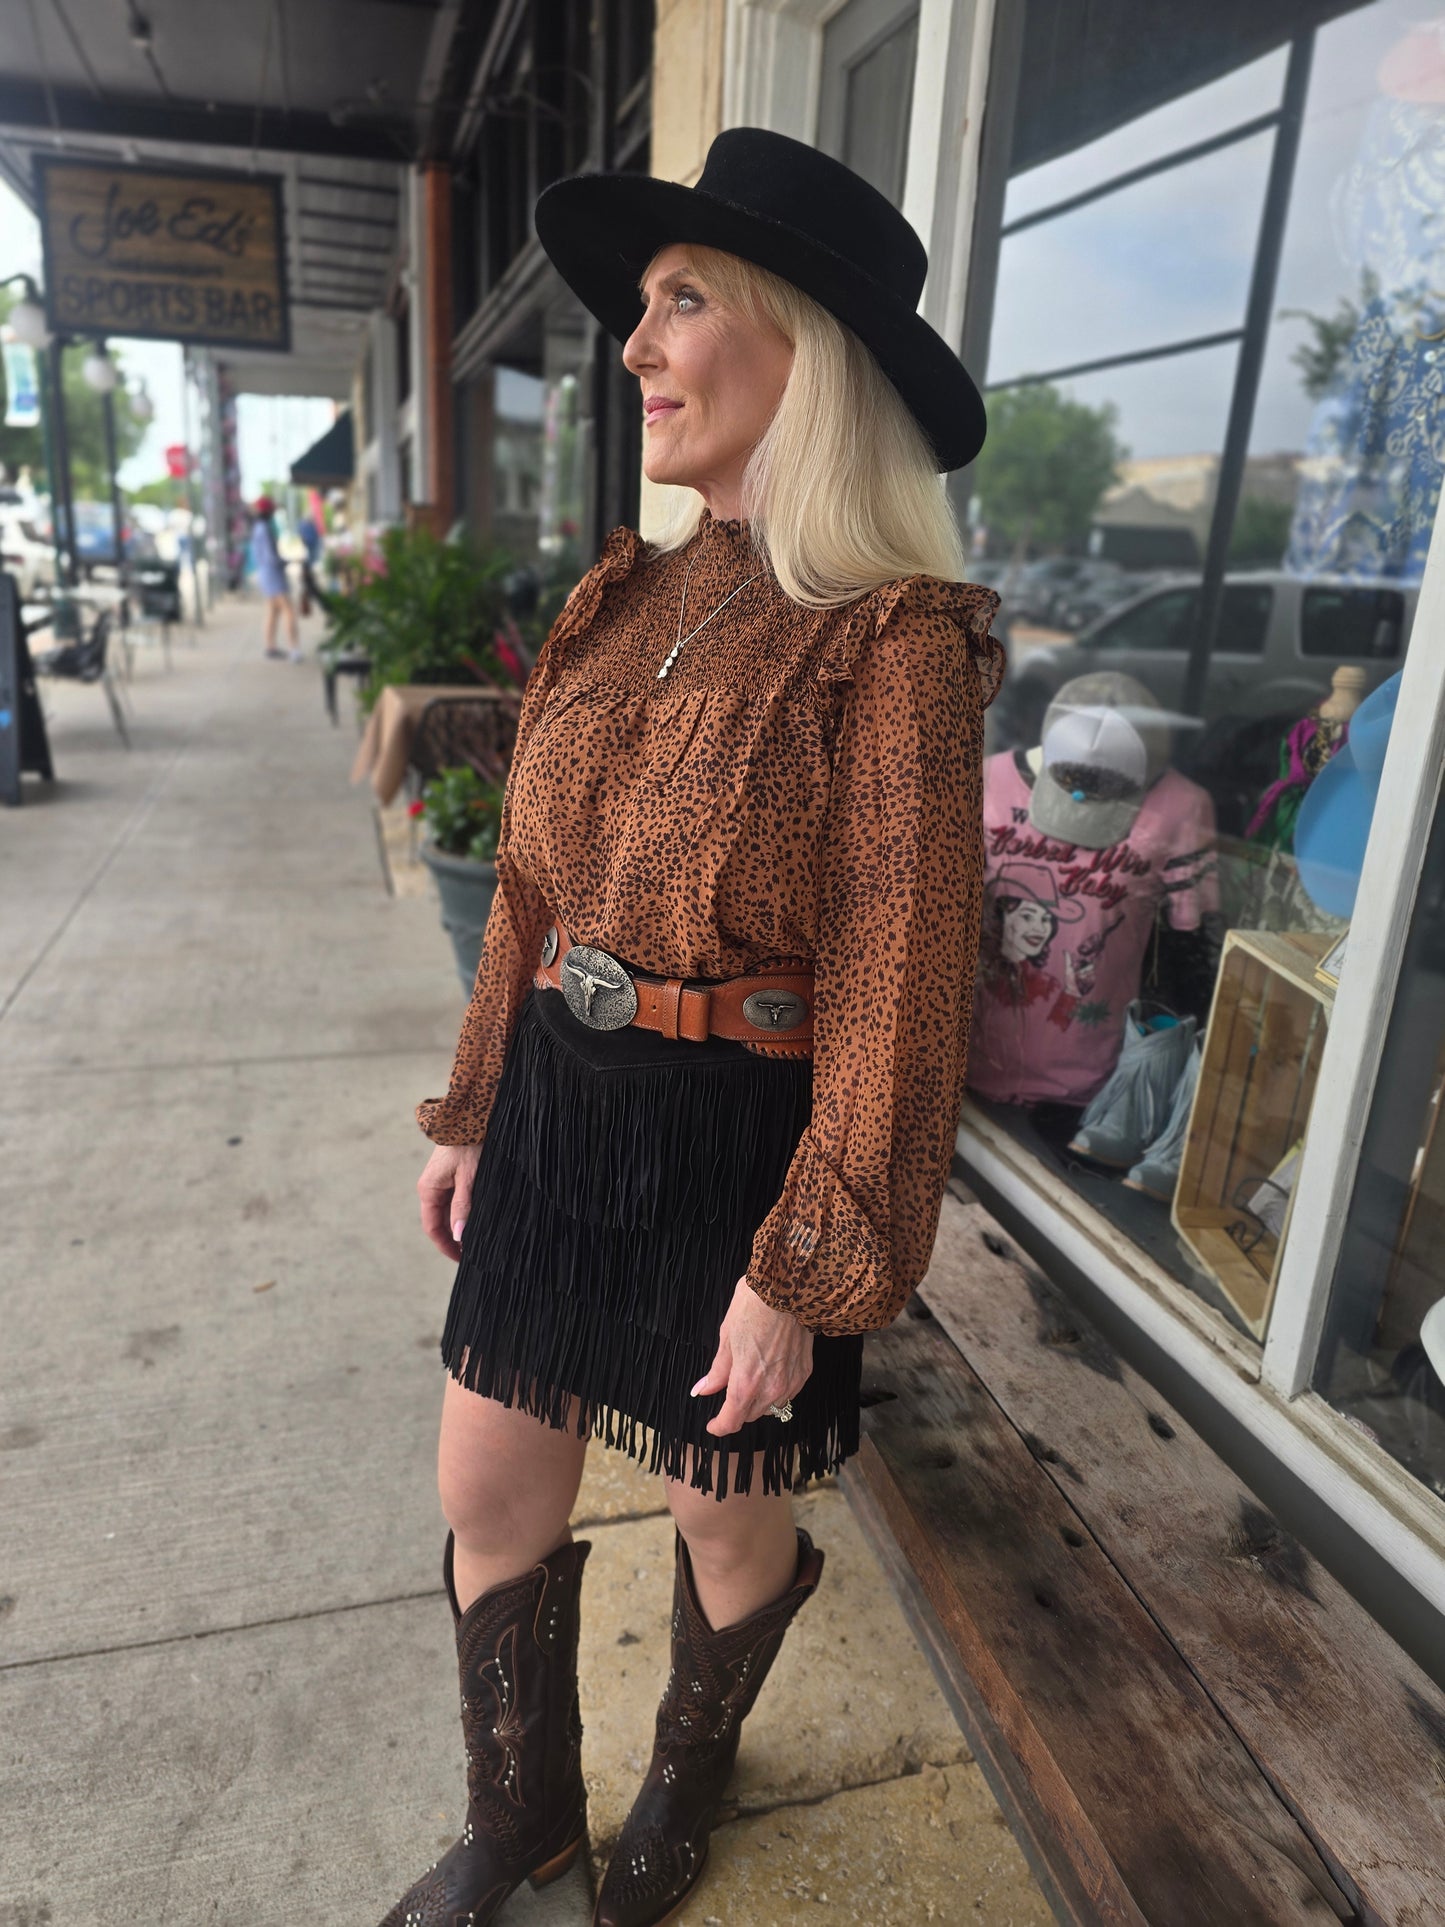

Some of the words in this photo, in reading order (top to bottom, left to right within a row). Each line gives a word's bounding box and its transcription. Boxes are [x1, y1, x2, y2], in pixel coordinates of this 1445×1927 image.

[69, 181, 160, 260] Joe
[61, 273, 198, 326] SPORTS
[202, 284, 272, 330] BAR
[1058, 865, 1128, 910] Baby
